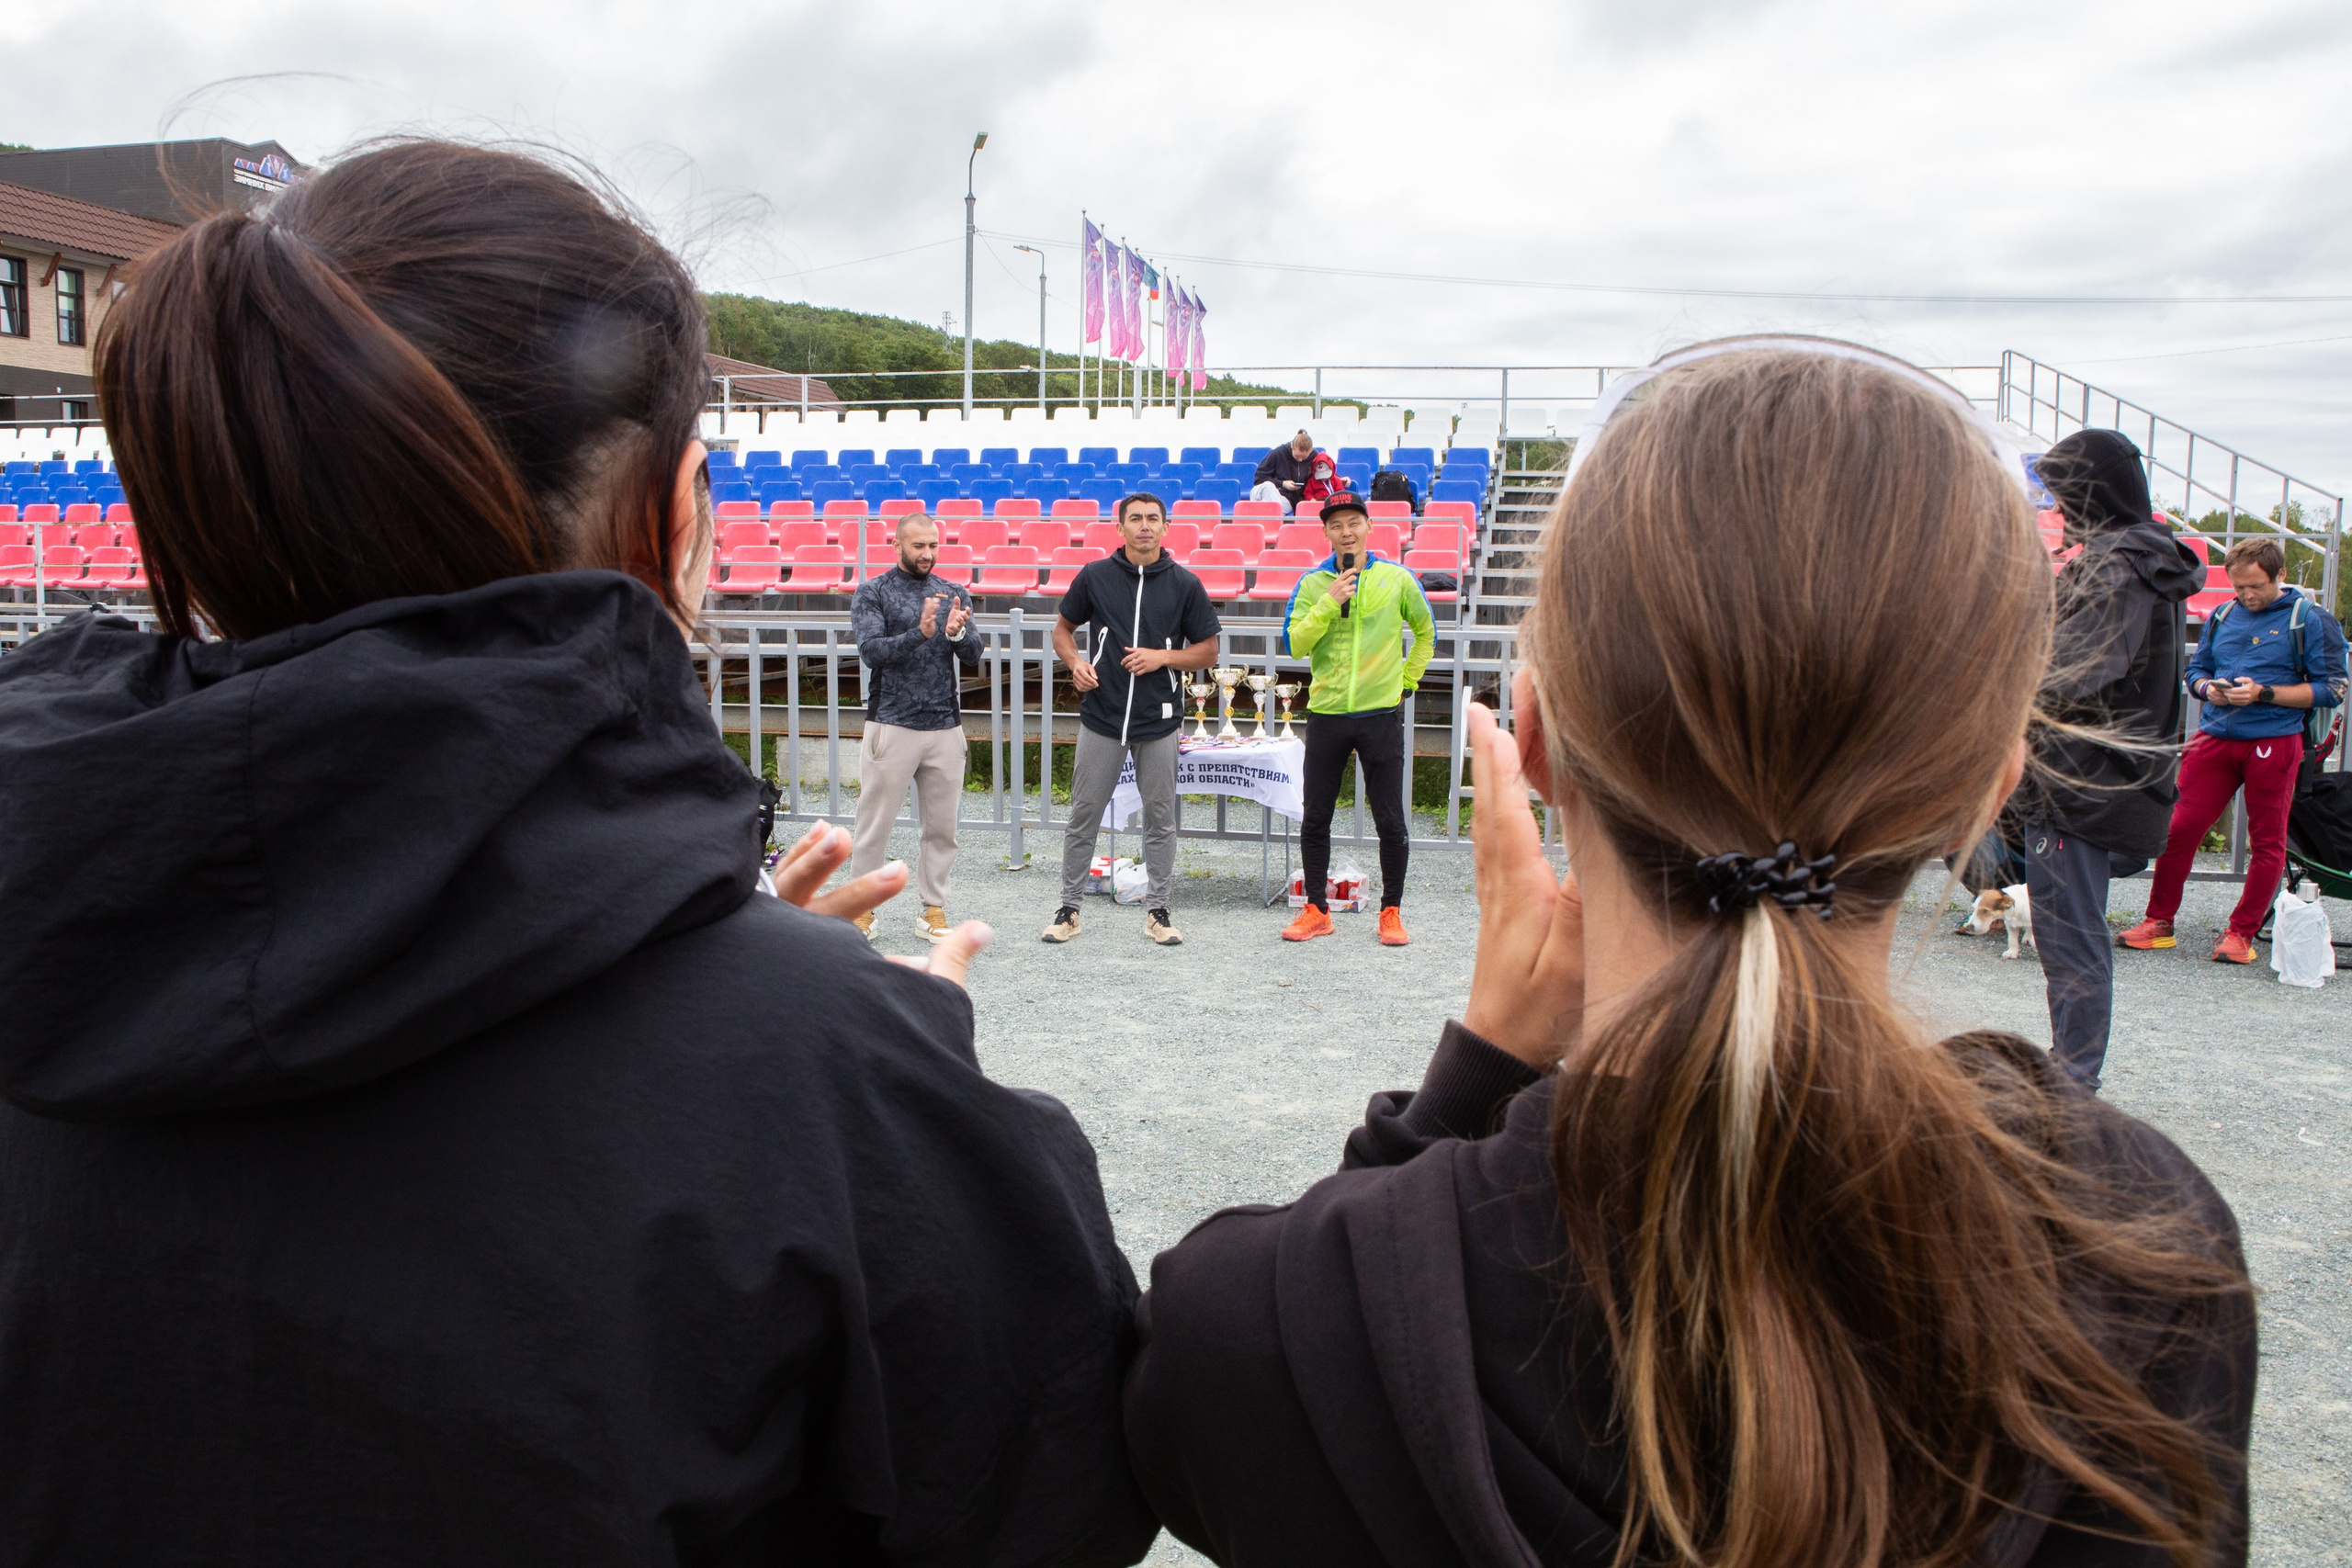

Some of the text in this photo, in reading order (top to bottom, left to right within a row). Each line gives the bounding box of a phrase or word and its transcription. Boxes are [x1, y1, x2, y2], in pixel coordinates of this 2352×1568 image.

[1329, 493, 1352, 503] PRIDE
[1187, 763, 1194, 772] С
[1199, 774, 1255, 788] ОБЛАСТИ»
